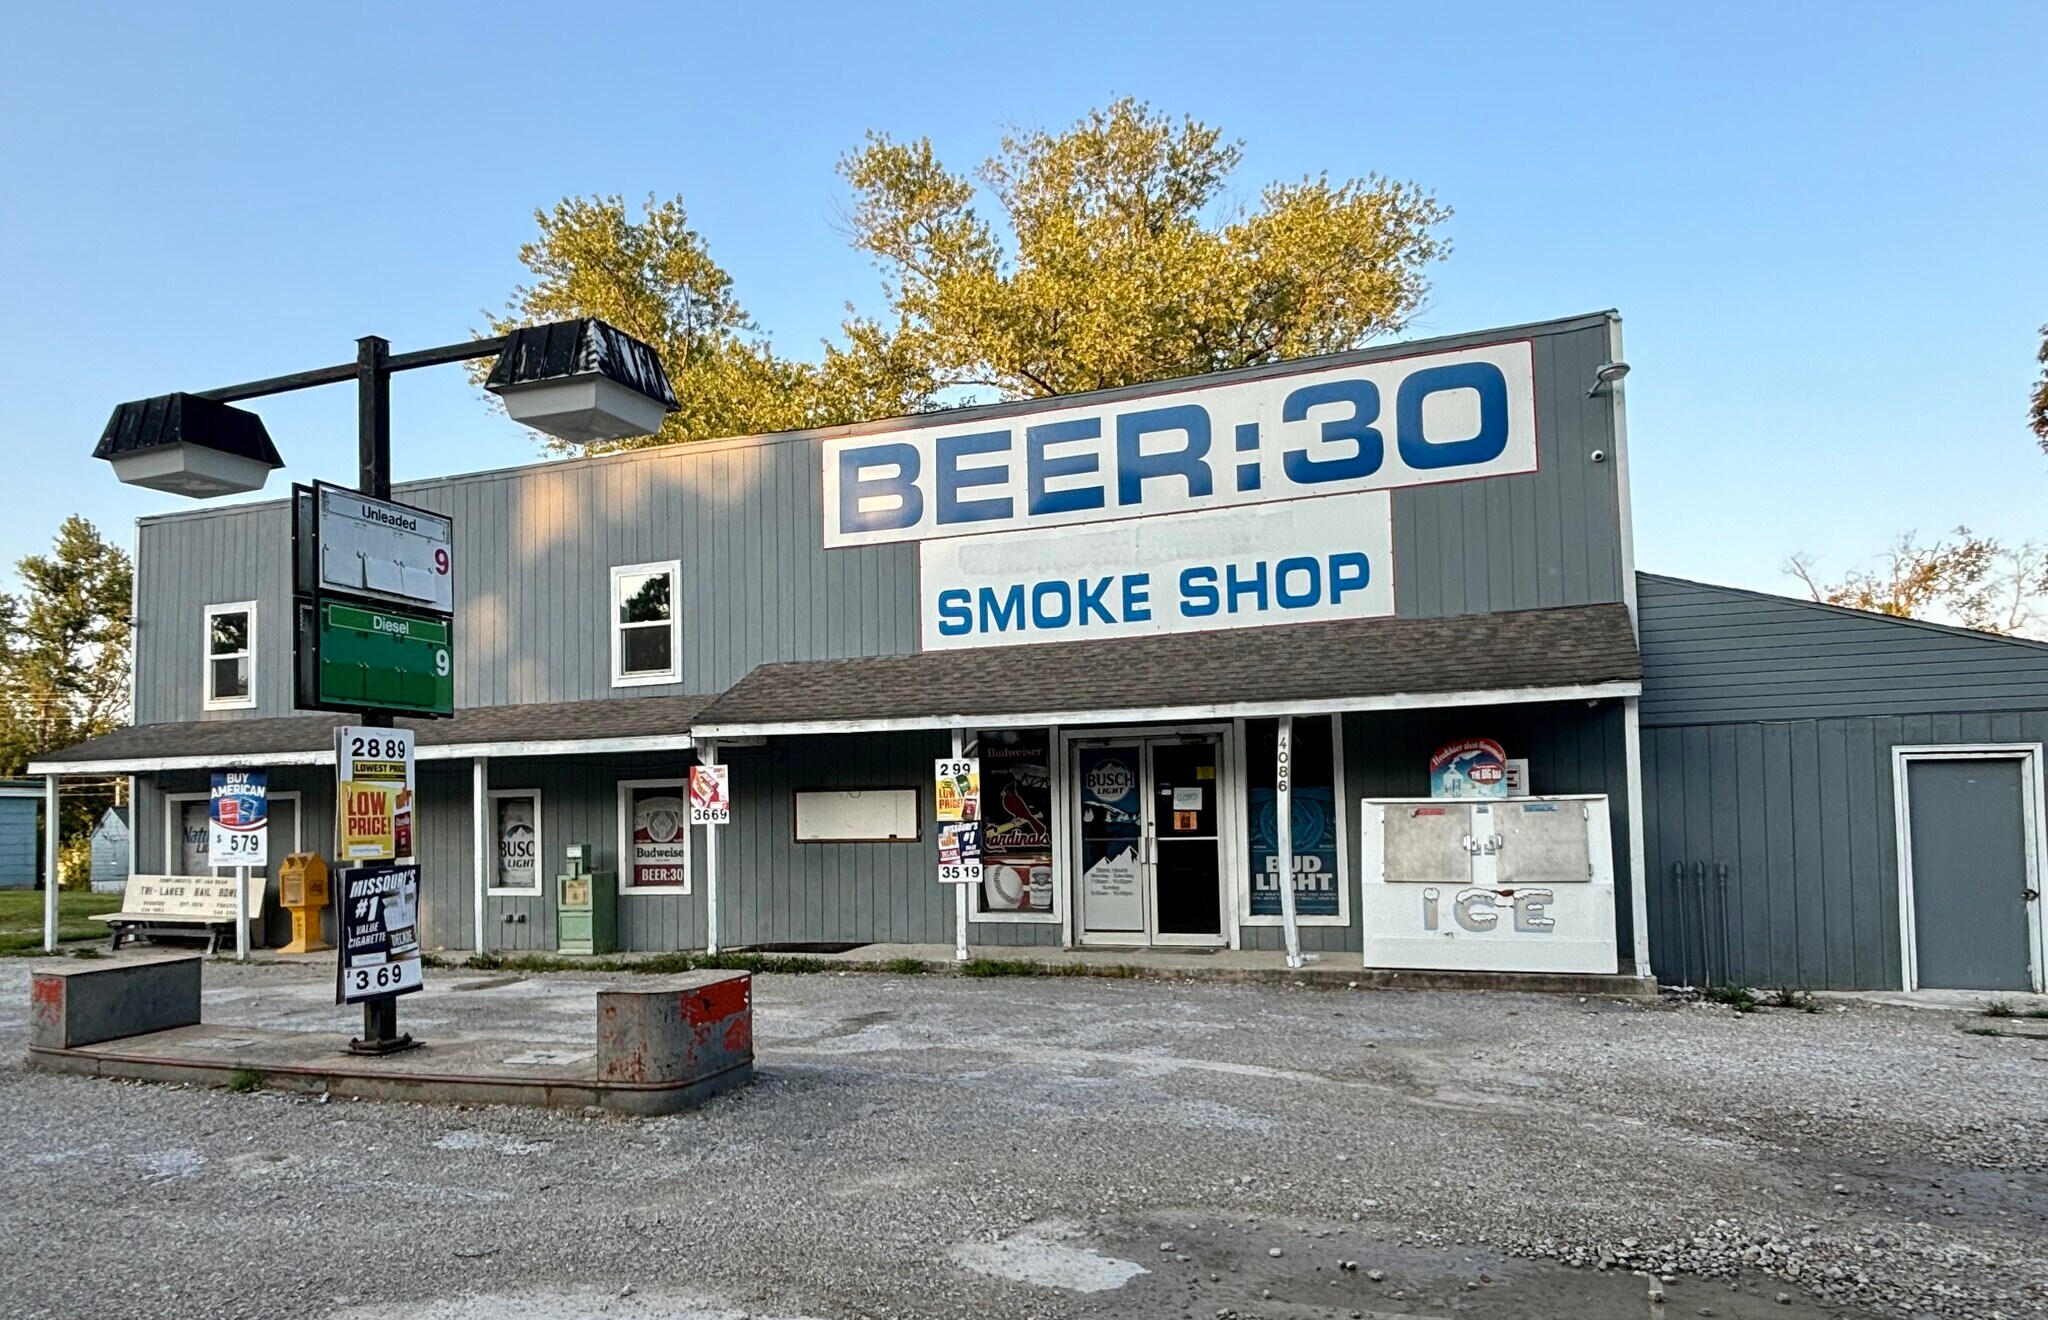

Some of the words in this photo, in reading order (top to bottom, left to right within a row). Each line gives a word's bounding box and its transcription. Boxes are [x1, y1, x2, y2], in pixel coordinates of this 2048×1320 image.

[839, 361, 1510, 534] BEER:30
[362, 504, 417, 531] Unleaded
[434, 549, 449, 575] 9
[938, 572, 1152, 636] SMOKE
[1179, 551, 1371, 617] SHOP
[373, 615, 409, 635] Diesel
[435, 649, 450, 676] 9
[987, 747, 1042, 758] Budweiser
[355, 763, 387, 773] LOWEST
[226, 773, 249, 784] BUY
[1087, 771, 1134, 788] BUSCH
[211, 784, 266, 800] AMERICAN
[938, 787, 956, 798] LOW
[1097, 787, 1124, 795] LIGHT
[347, 791, 387, 817] LOW
[348, 816, 392, 836] PRICE!
[982, 823, 1052, 853] Cardinals
[500, 840, 535, 858] BUSC
[636, 847, 684, 857] Budweise
[641, 868, 683, 881] BEER:30
[194, 887, 211, 897] BAIL
[350, 869, 416, 899] MISSOURI'S
[355, 896, 379, 921] #1
[1423, 887, 1556, 933] ICE
[356, 921, 379, 935] VALUE
[347, 931, 386, 949] CIGARETTE
